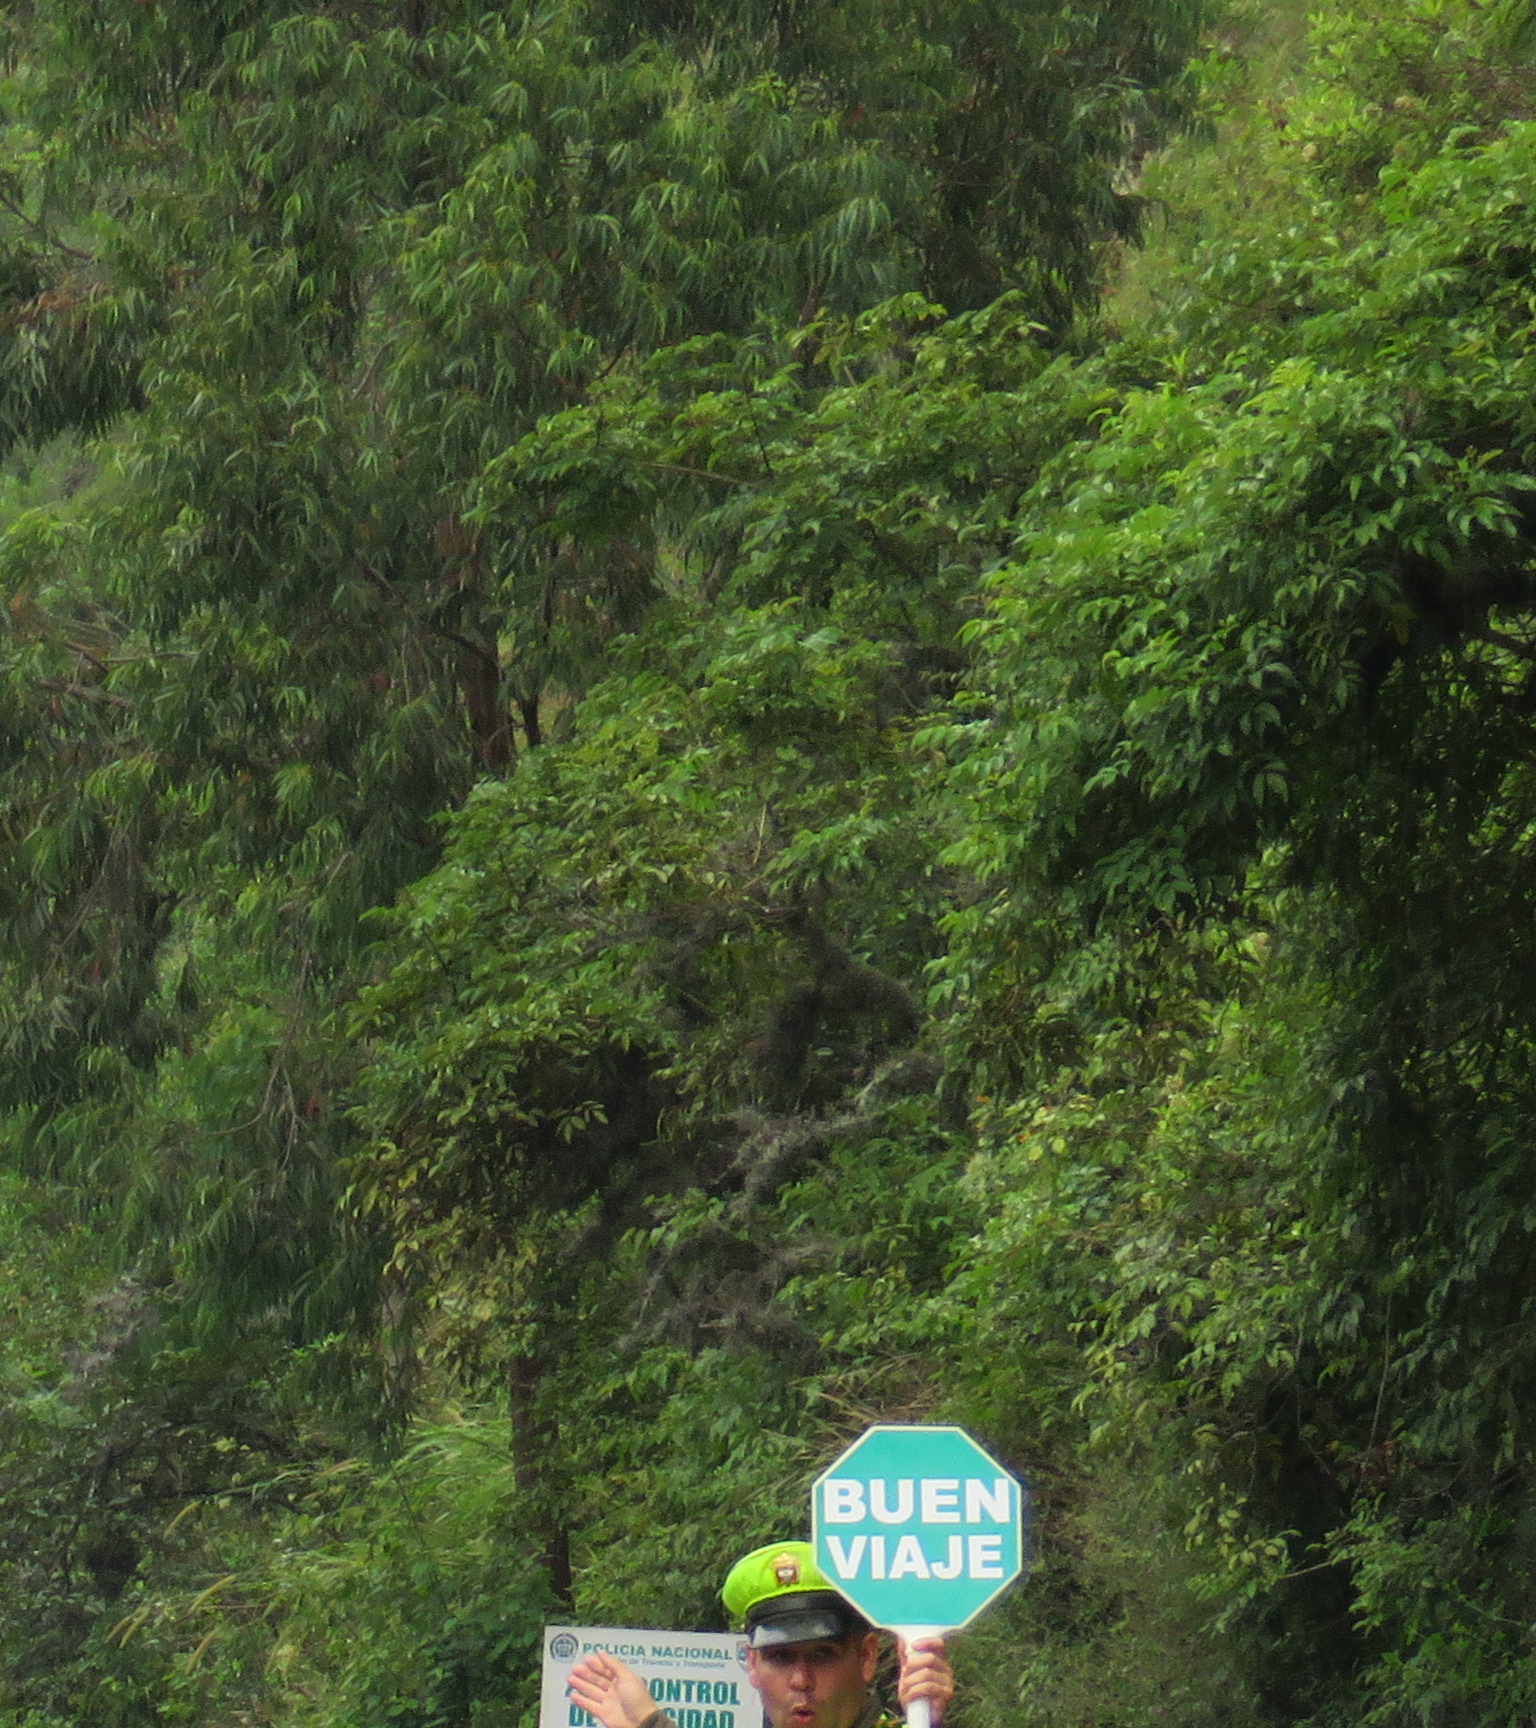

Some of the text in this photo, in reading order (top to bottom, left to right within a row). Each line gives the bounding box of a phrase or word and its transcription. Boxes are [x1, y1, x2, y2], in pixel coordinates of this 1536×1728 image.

[823, 1477, 1012, 1525] BUEN
[825, 1534, 1006, 1580] VIAJE
[651, 1644, 733, 1661] NACIONAL
